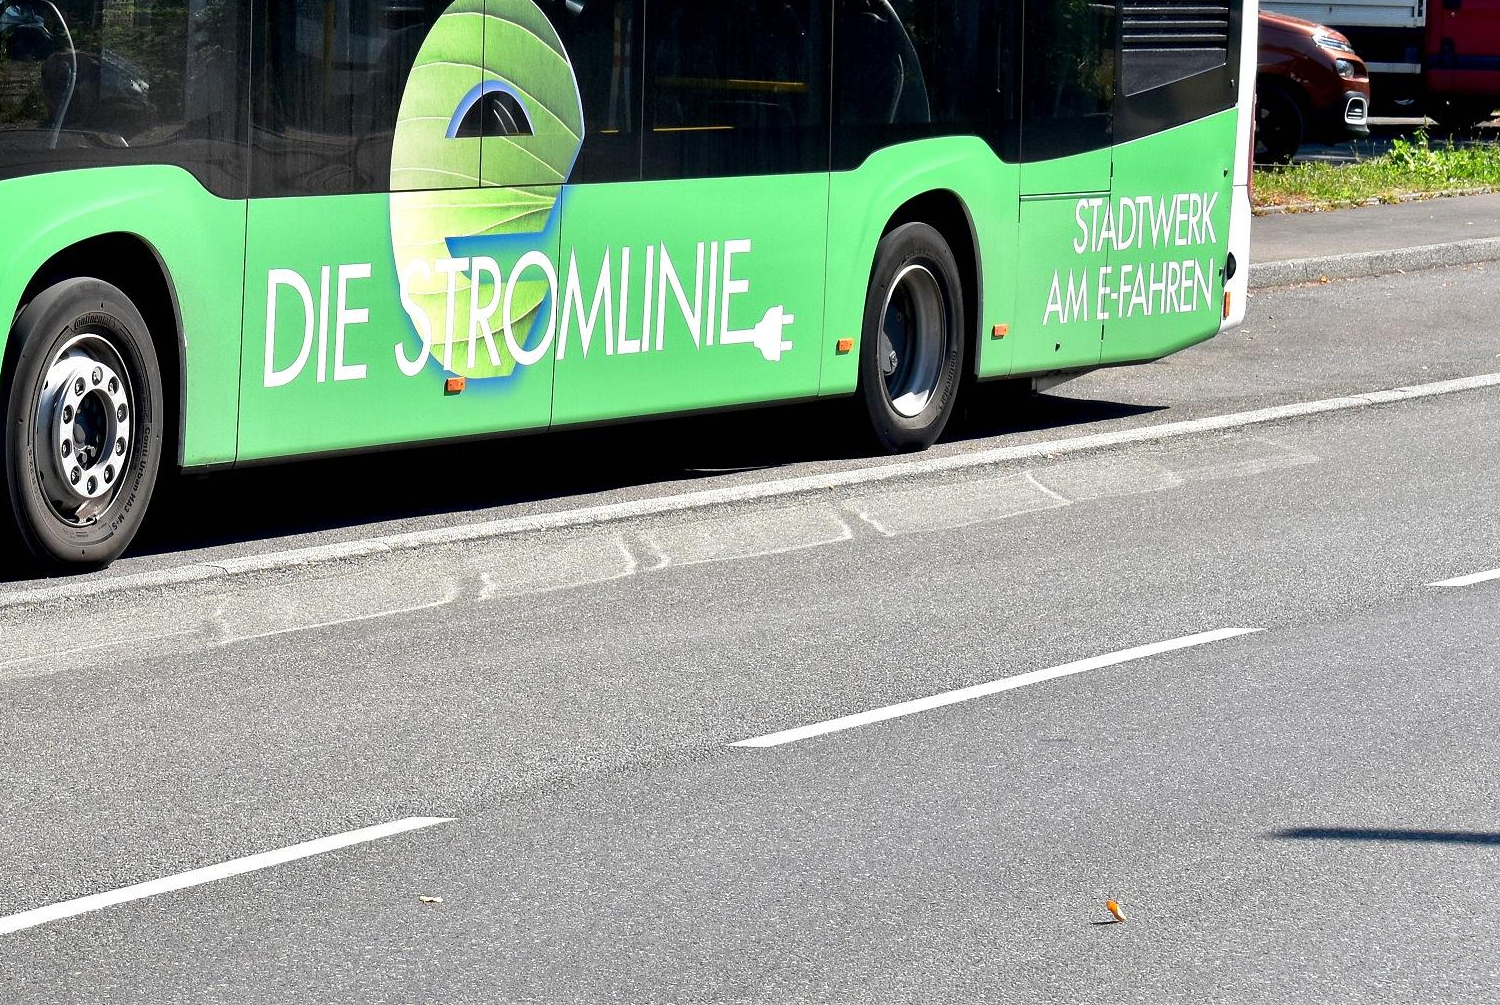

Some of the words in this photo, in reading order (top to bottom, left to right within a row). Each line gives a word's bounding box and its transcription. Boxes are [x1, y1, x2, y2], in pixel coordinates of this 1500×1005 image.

[1073, 191, 1219, 255] STADTWERK
[263, 262, 372, 388] DIE
[394, 238, 754, 378] STROMLINIE
[1043, 267, 1088, 325] AM
[1096, 258, 1214, 320] E-FAHREN
